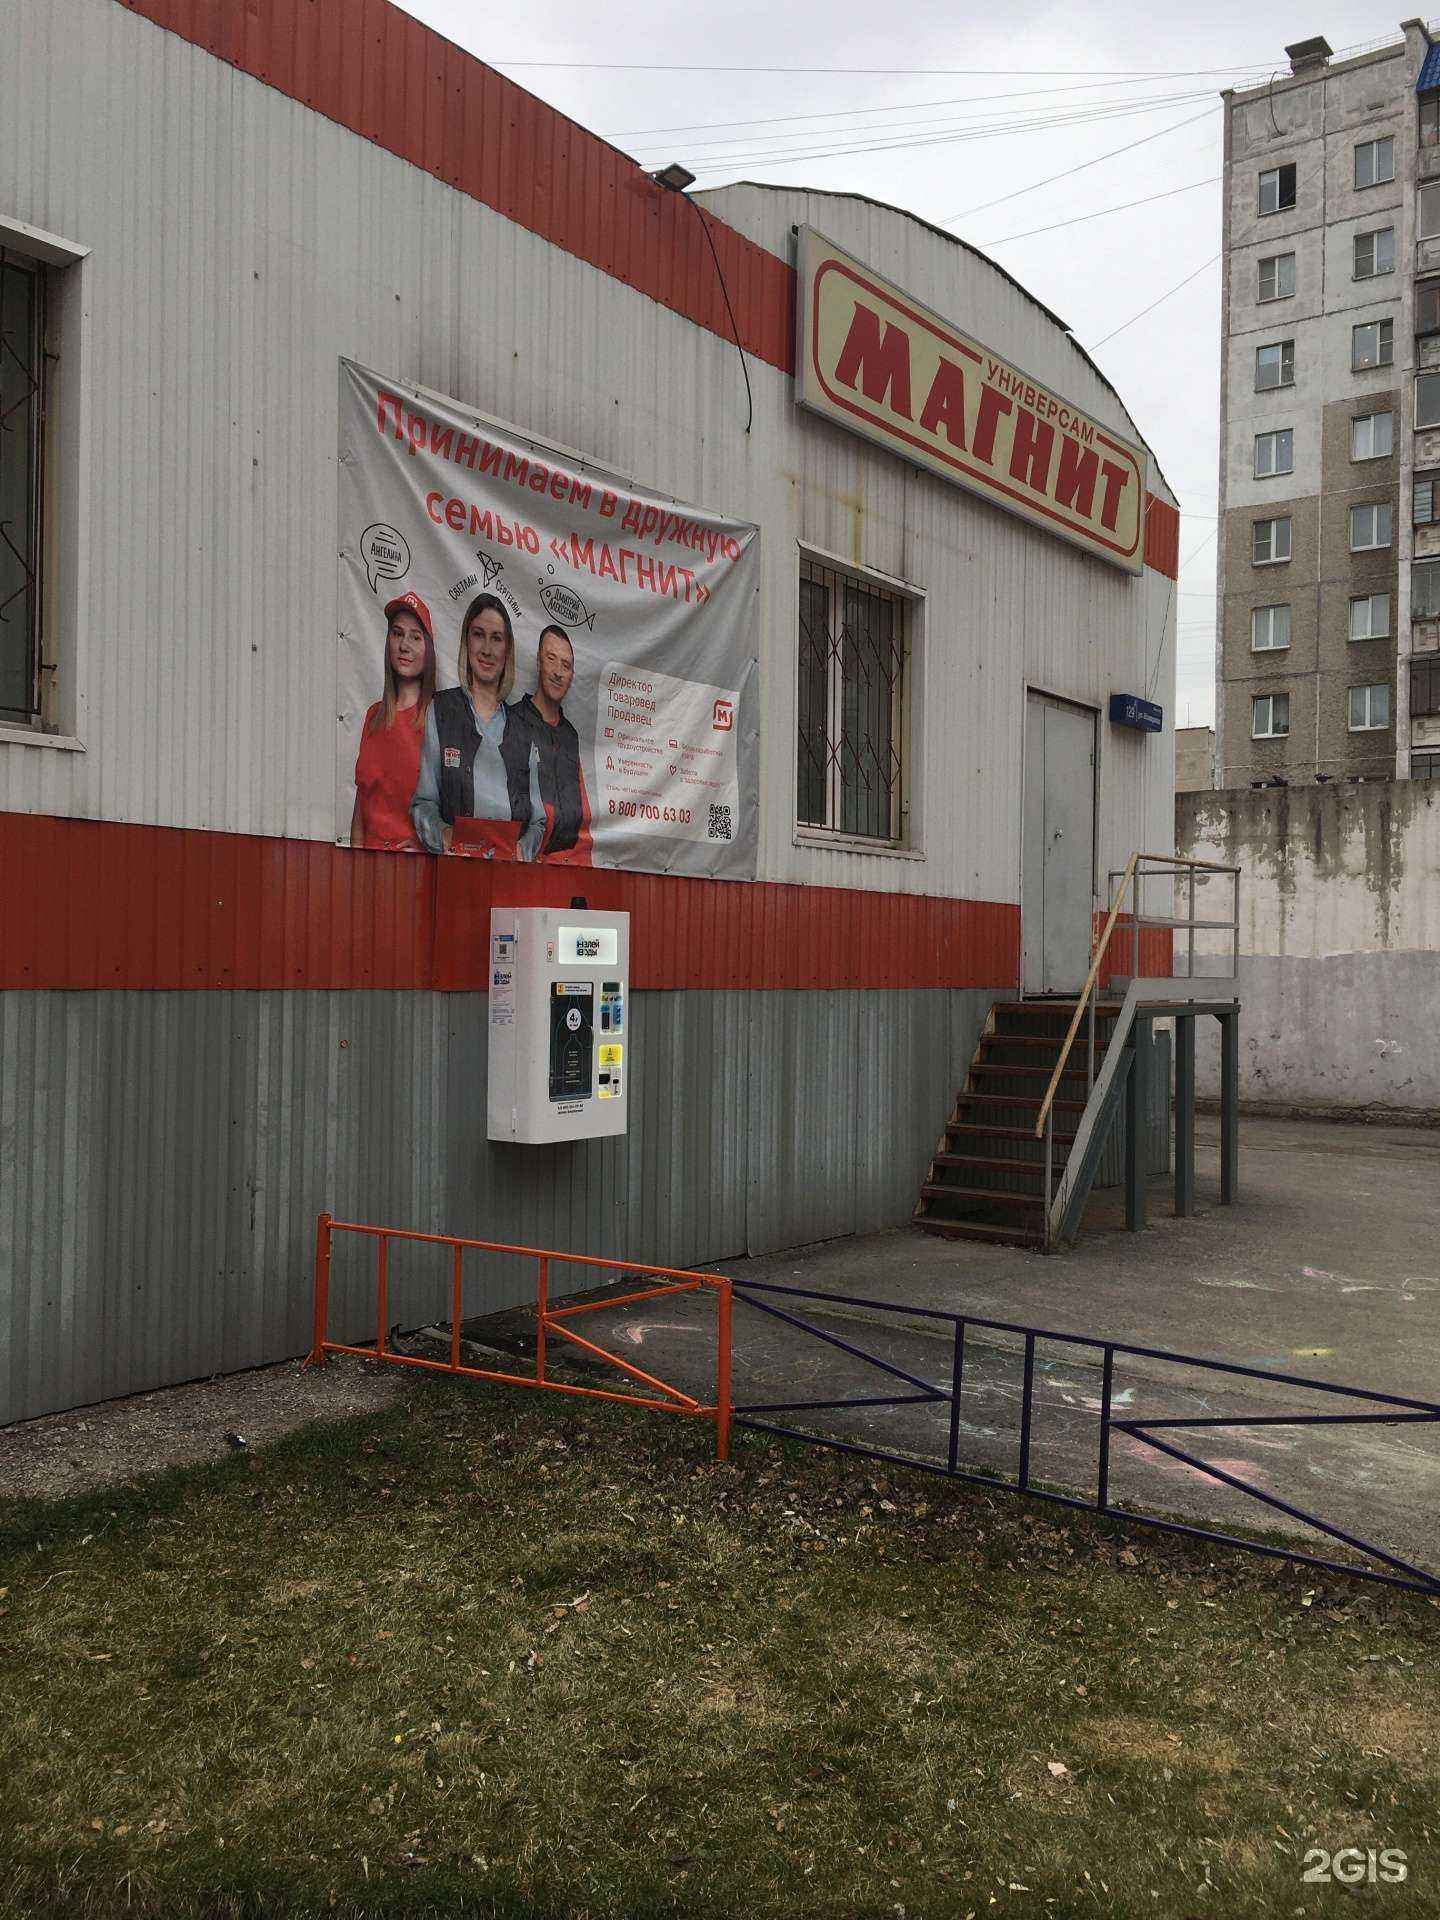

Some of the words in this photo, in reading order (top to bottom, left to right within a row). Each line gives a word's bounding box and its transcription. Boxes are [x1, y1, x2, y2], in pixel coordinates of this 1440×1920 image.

[834, 300, 1130, 533] МАГНИТ
[987, 358, 1095, 445] УНИВЕРСАМ
[376, 389, 593, 512] Принимаем
[600, 490, 618, 518] в
[621, 500, 743, 566] дружную
[425, 491, 541, 556] семью
[550, 532, 711, 607] «МАГНИТ»
[608, 672, 653, 695] Директор
[608, 688, 657, 713] Товаровед
[607, 705, 653, 726] Продавец
[608, 799, 616, 814] 8
[618, 801, 637, 818] 800
[640, 803, 660, 820] 700
[663, 806, 677, 822] 63
[679, 809, 691, 824] 03
